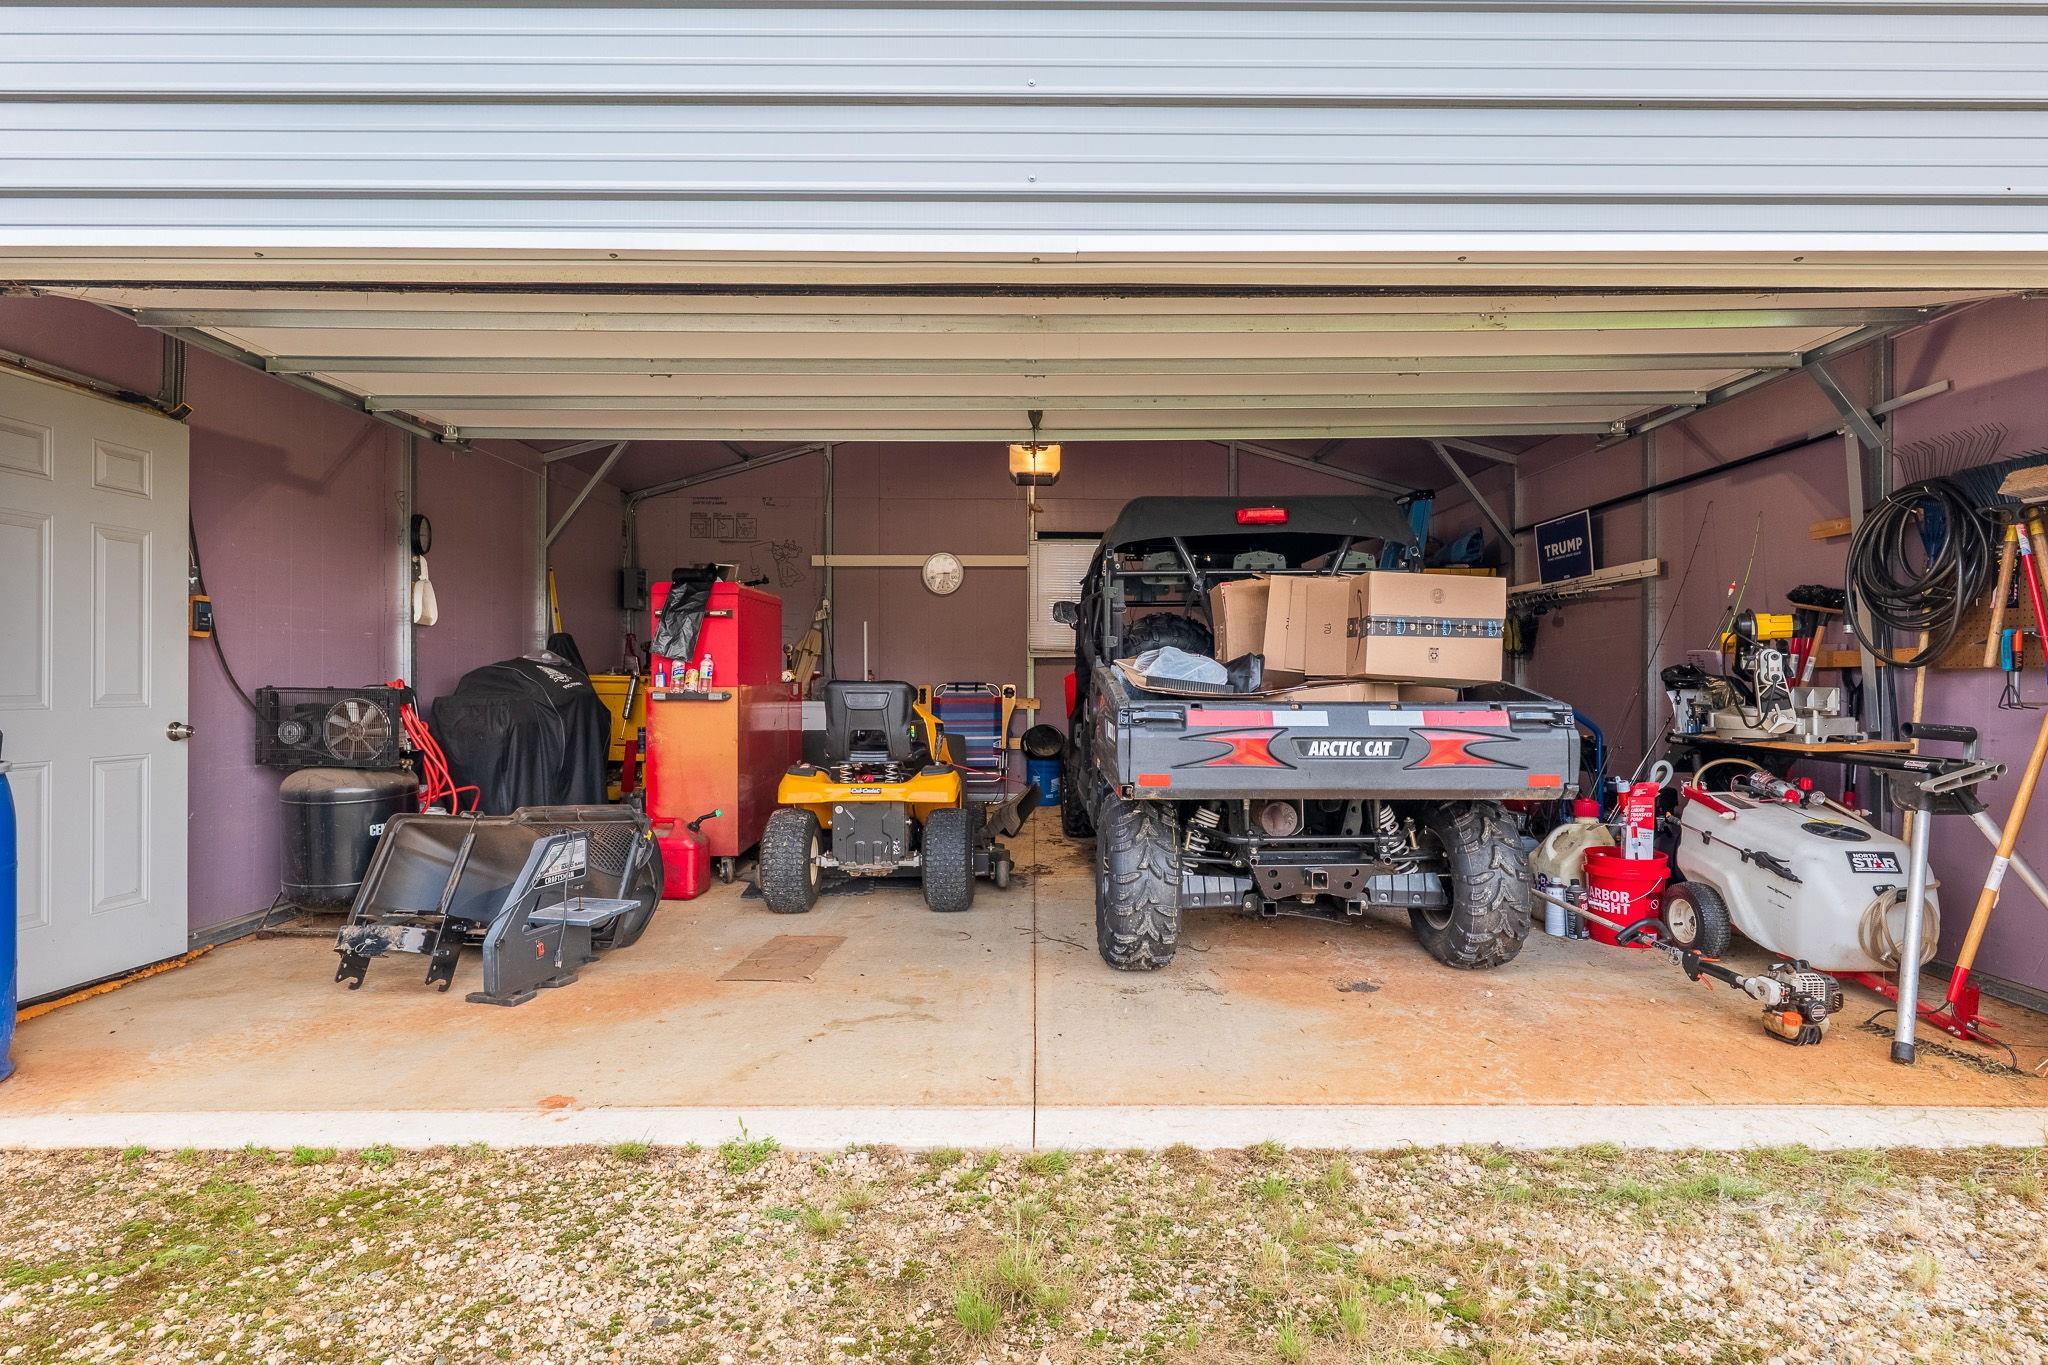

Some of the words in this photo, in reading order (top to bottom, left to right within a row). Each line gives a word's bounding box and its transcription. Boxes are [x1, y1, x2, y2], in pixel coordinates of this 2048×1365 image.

[1544, 537, 1583, 558] TRUMP
[1308, 741, 1361, 757] ARCTIC
[1364, 741, 1393, 757] CAT
[370, 823, 387, 836] CEN
[1852, 857, 1897, 868] STAR
